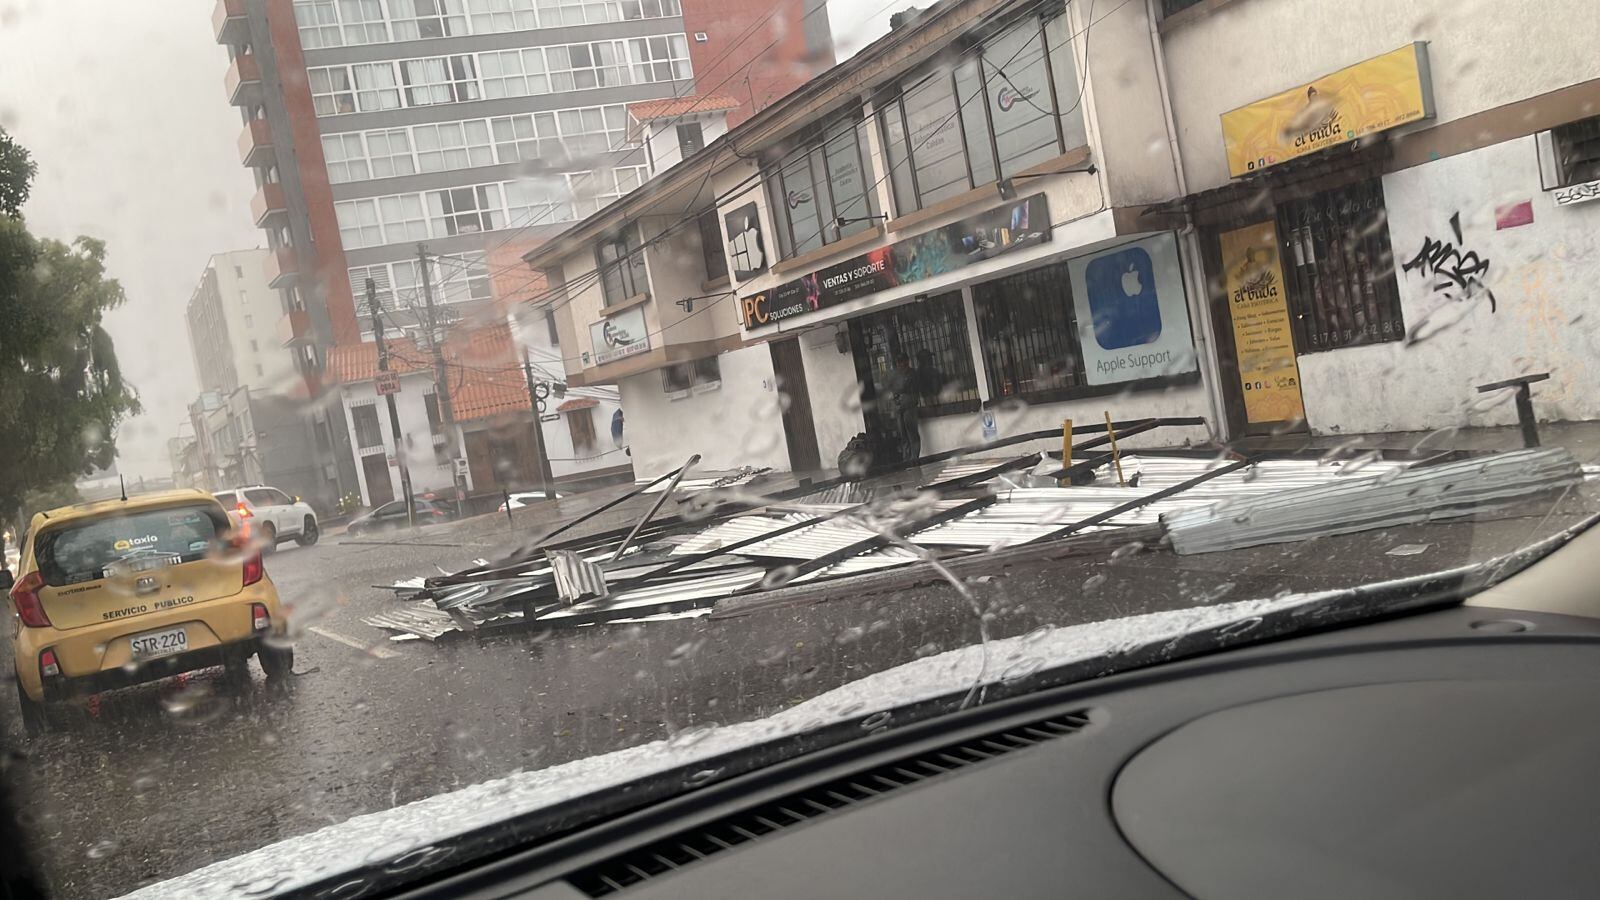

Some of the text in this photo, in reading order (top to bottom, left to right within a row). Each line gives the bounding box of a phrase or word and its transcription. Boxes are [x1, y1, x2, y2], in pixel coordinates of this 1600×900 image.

[1308, 122, 1342, 142] buda
[822, 272, 848, 289] VENTAS
[847, 270, 854, 281] Y
[853, 259, 886, 280] SOPORTE
[1247, 285, 1278, 301] buda
[769, 303, 804, 321] SOLUCIONES
[1096, 350, 1172, 374] Apple Support
[102, 595, 194, 621] SERVICIO PUBLICO
